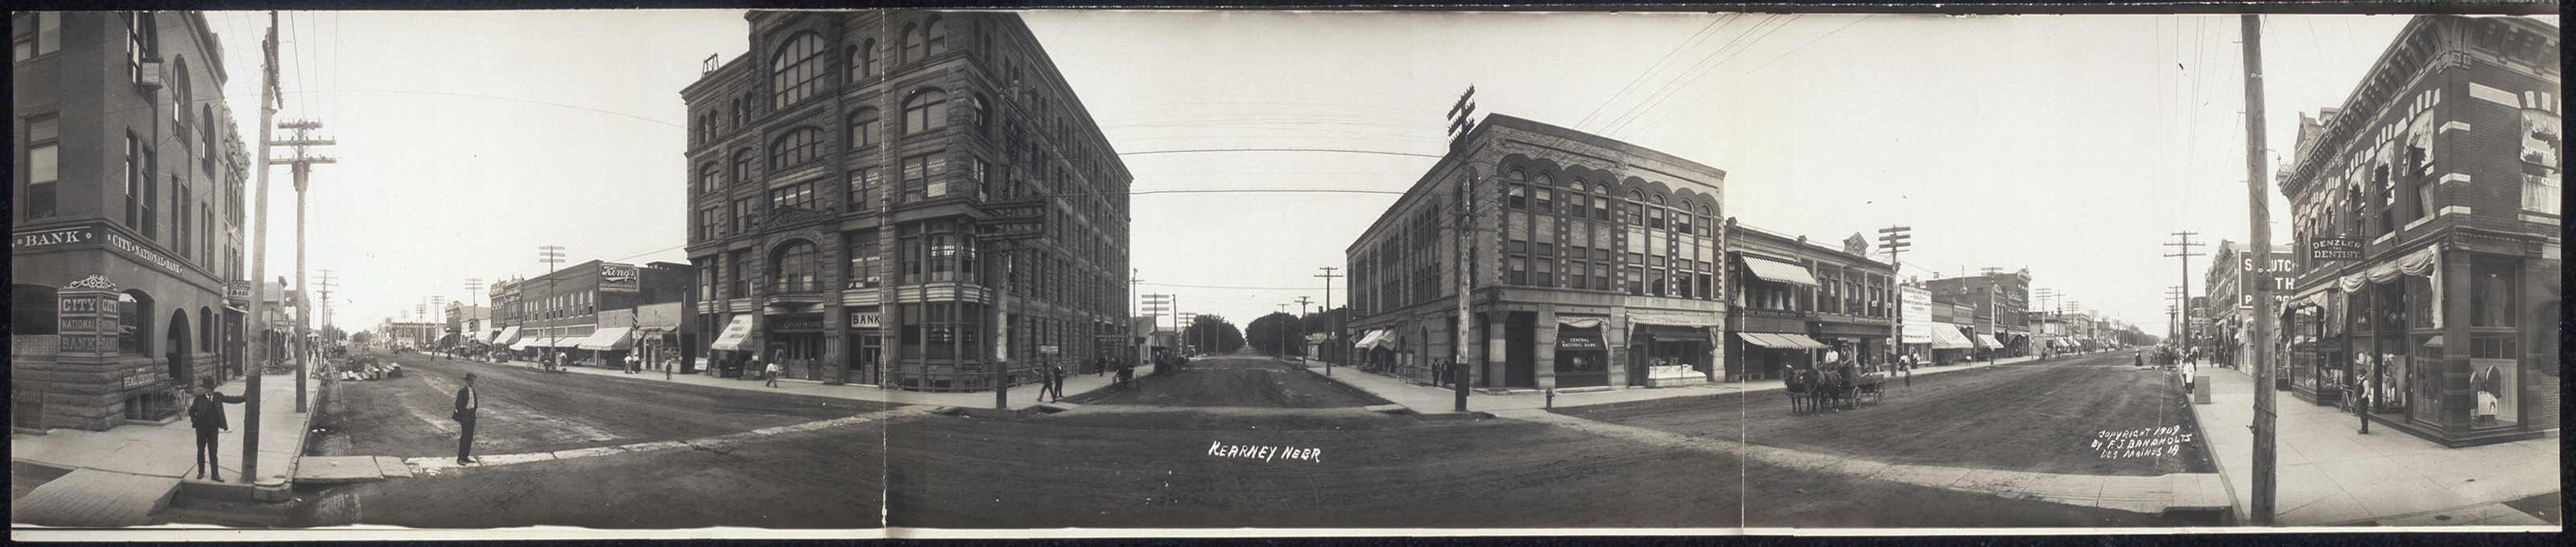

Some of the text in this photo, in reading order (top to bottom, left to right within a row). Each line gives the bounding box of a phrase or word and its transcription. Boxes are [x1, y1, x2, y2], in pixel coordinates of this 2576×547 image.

[25, 230, 80, 247] BANK
[2313, 240, 2361, 249] DENZLER
[112, 234, 180, 274] CITY NATIONAL BANK
[601, 265, 636, 282] King's
[63, 298, 96, 311] CITY
[102, 298, 118, 313] CITY
[62, 319, 96, 330] NATIONAL
[784, 320, 821, 329] OPERA HOUSE
[853, 315, 880, 325] BANK
[62, 338, 96, 350] BANK
